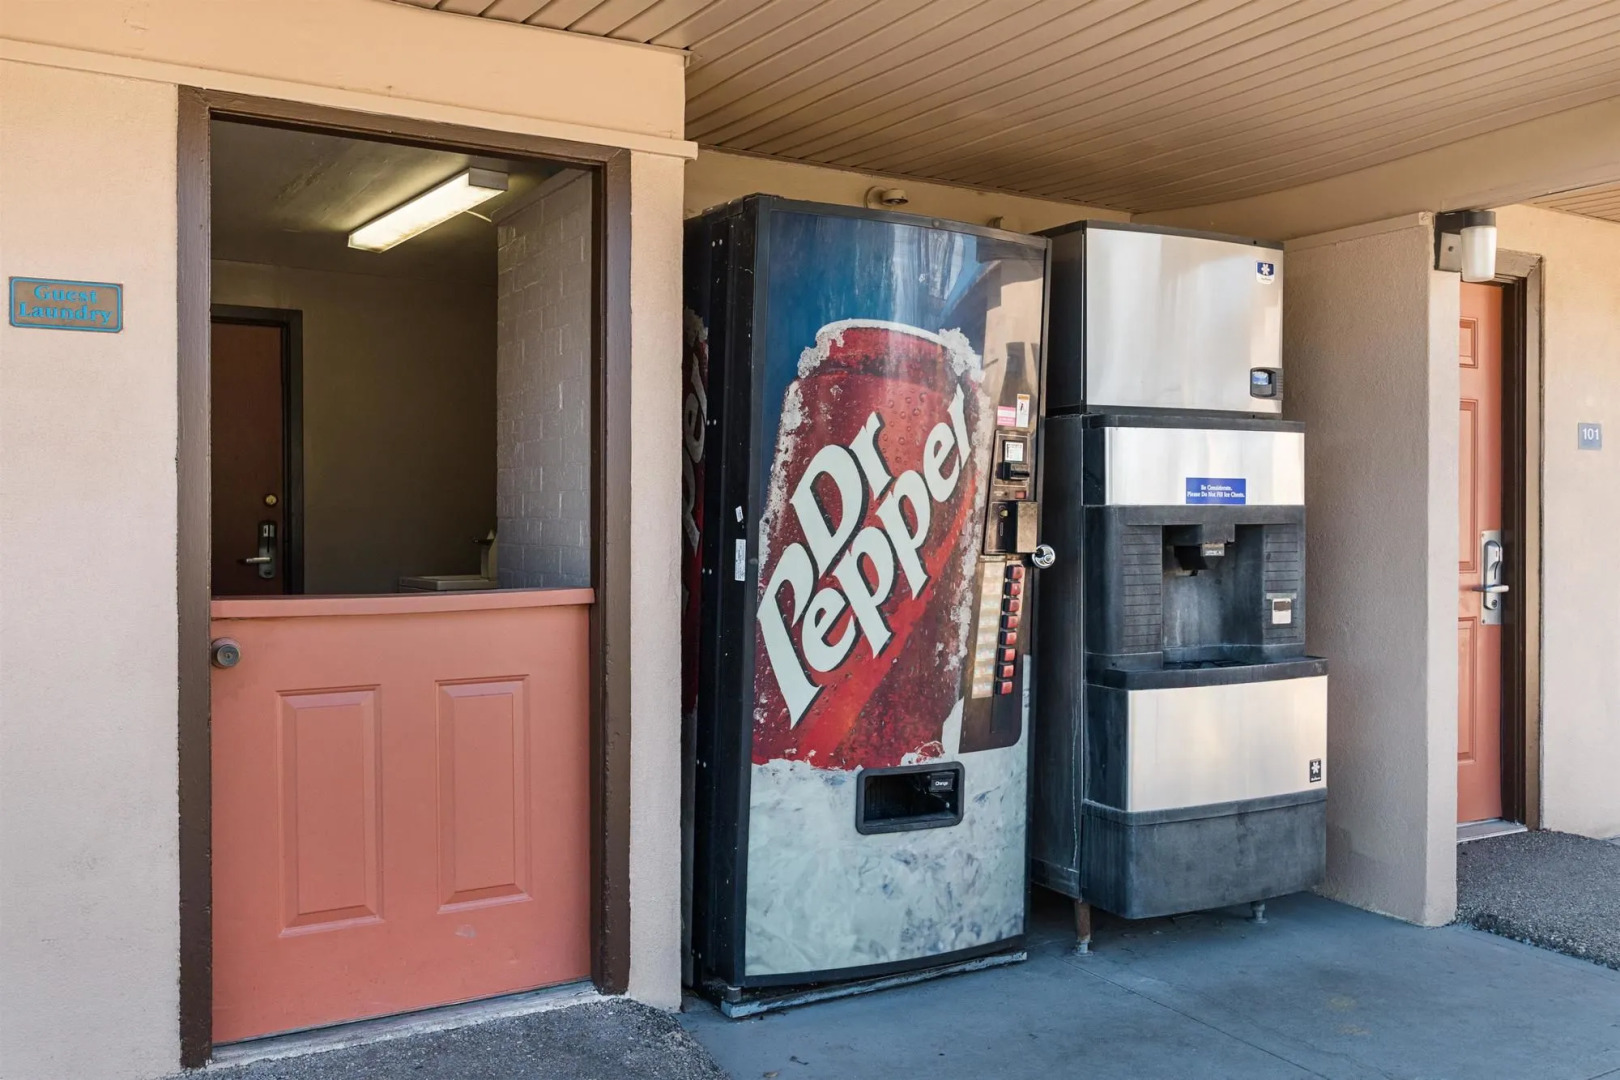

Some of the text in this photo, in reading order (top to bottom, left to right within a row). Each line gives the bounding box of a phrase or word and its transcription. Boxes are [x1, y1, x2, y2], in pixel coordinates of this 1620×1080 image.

[33, 285, 97, 304] Guest
[19, 301, 113, 325] Laundry
[1582, 428, 1599, 440] 101
[789, 411, 893, 579] Dr
[756, 384, 972, 730] Pepper
